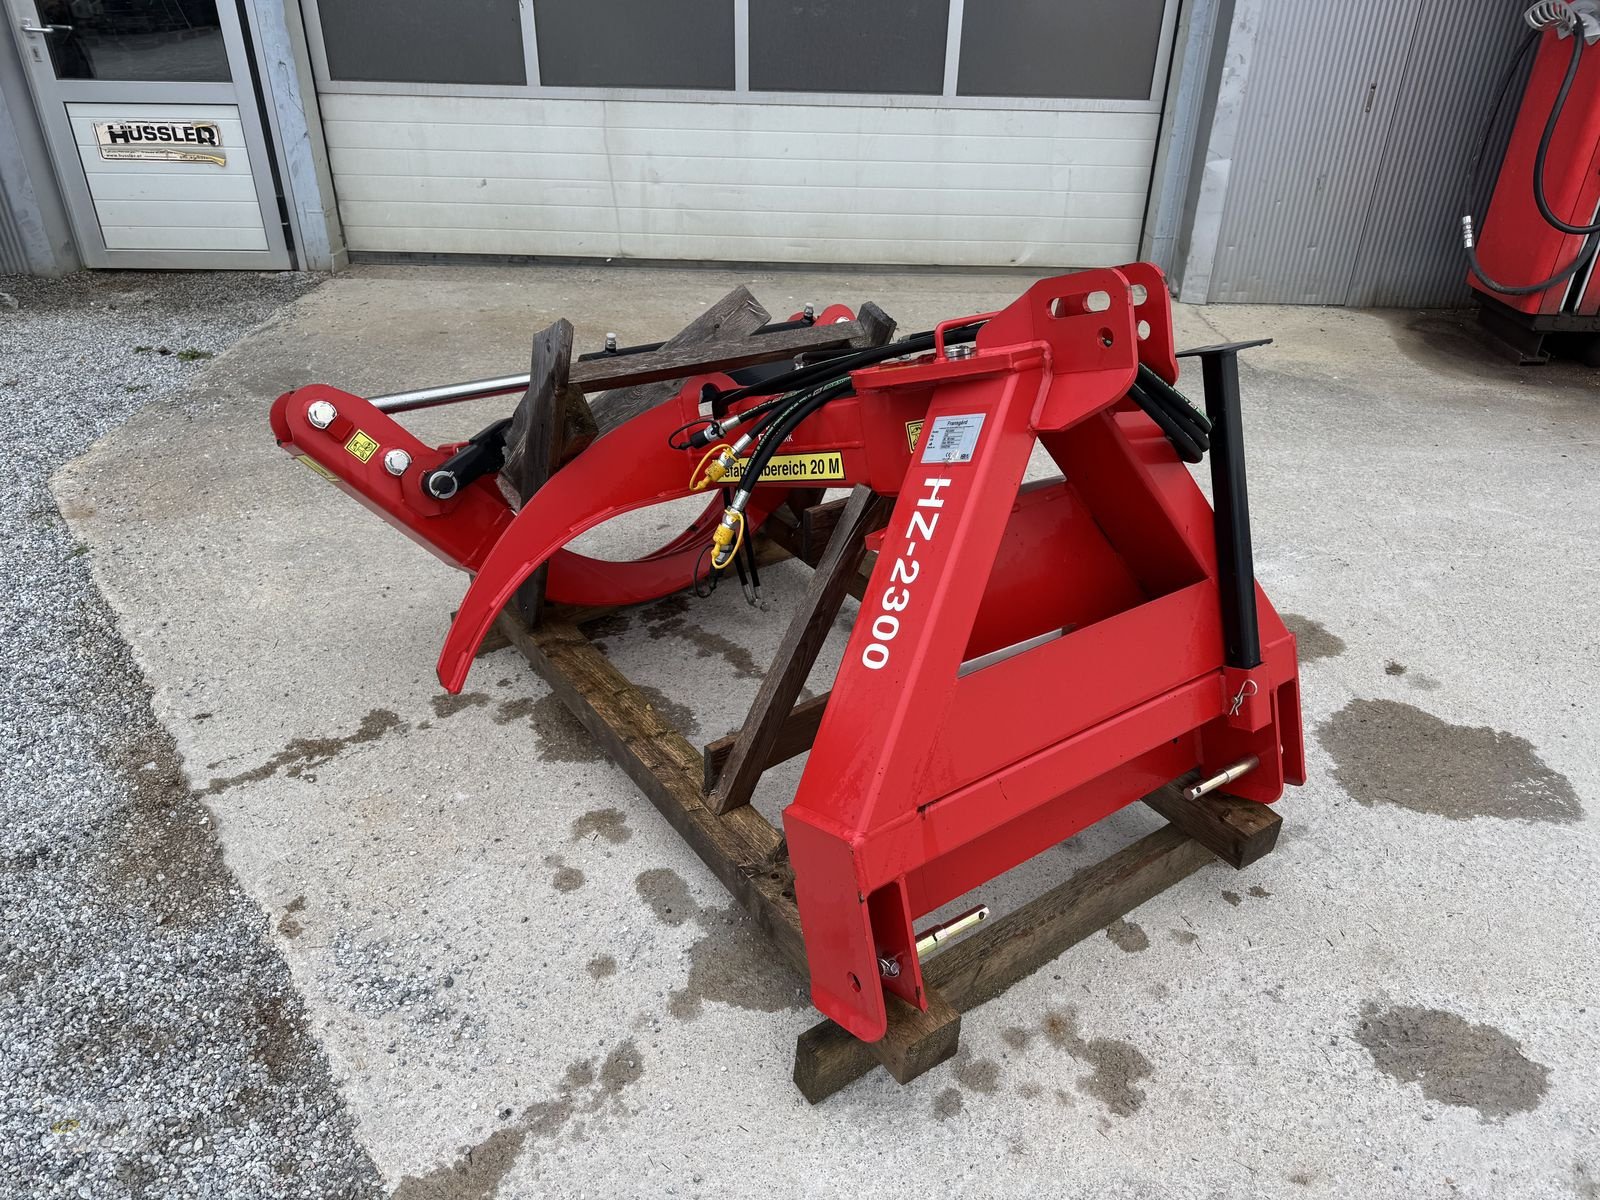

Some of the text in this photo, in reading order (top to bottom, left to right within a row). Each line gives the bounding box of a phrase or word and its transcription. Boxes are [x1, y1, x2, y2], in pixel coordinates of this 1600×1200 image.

[810, 459, 825, 475] 20
[828, 458, 840, 474] M
[861, 478, 952, 670] HZ-2300
